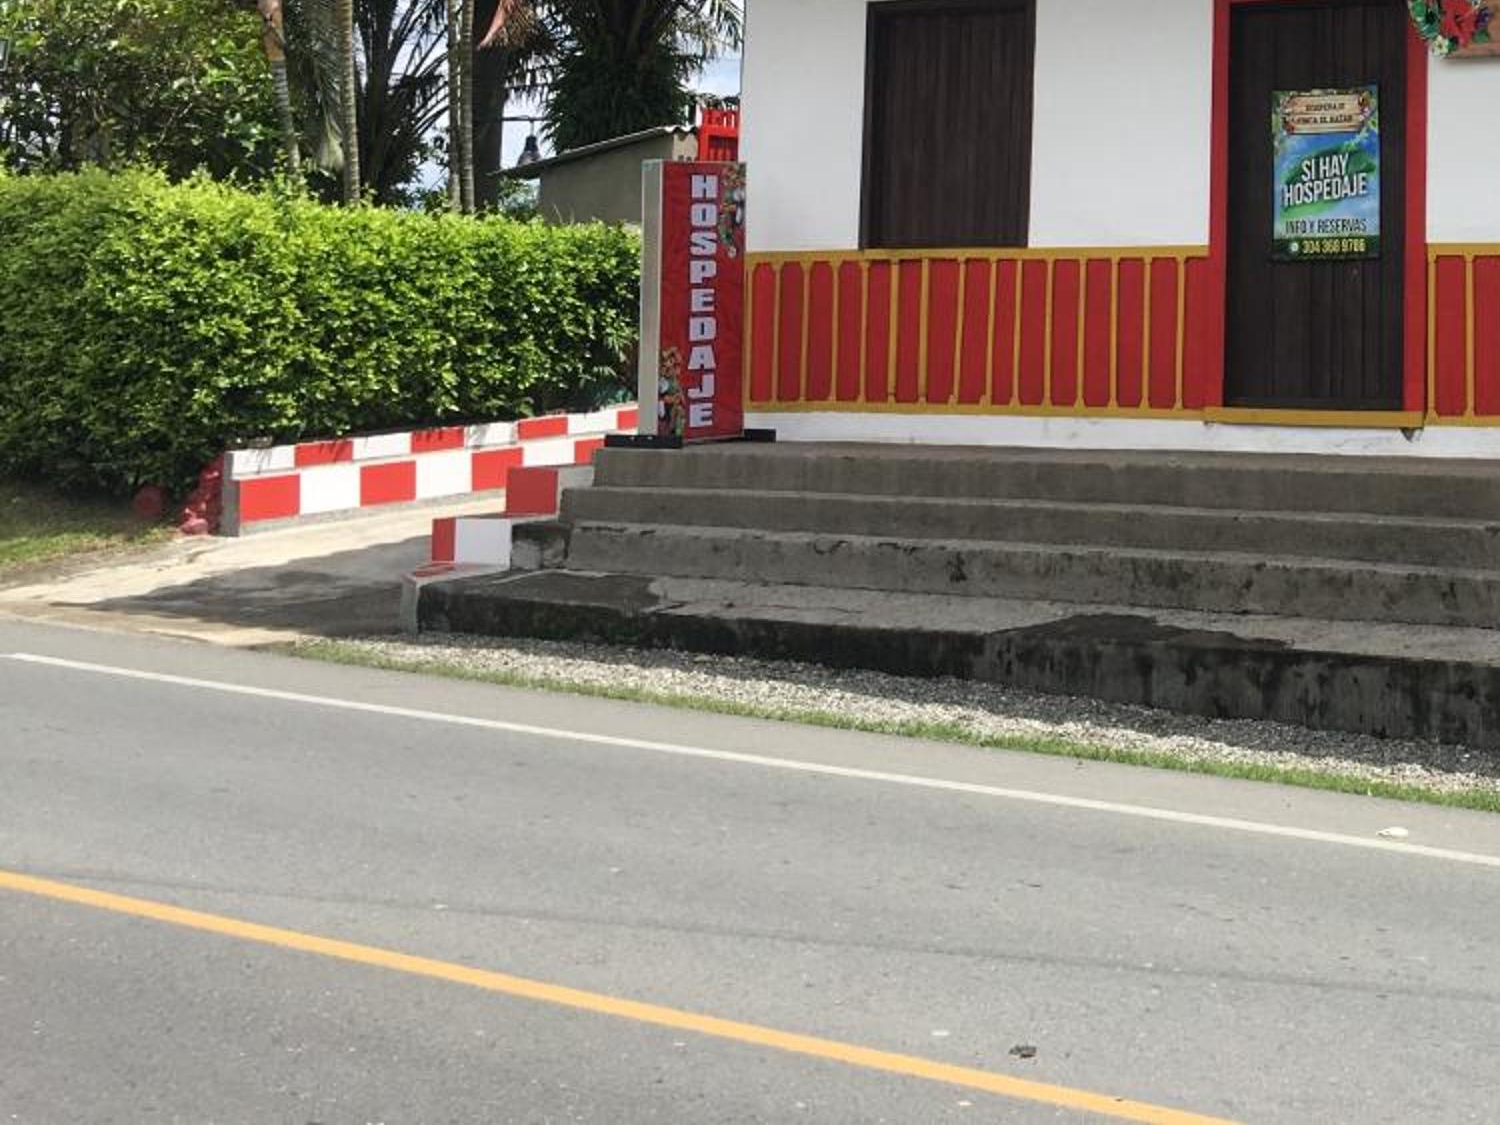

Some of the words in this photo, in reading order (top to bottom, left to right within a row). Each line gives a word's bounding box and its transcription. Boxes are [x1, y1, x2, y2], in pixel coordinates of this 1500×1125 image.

[1301, 160, 1315, 181] SI
[1319, 152, 1349, 177] HAY
[1283, 173, 1368, 206] HOSPEDAJE
[1286, 220, 1306, 234] INFO
[1309, 220, 1315, 233] Y
[1318, 218, 1367, 234] RESERVAS
[687, 174, 719, 427] HOSPEDAJE
